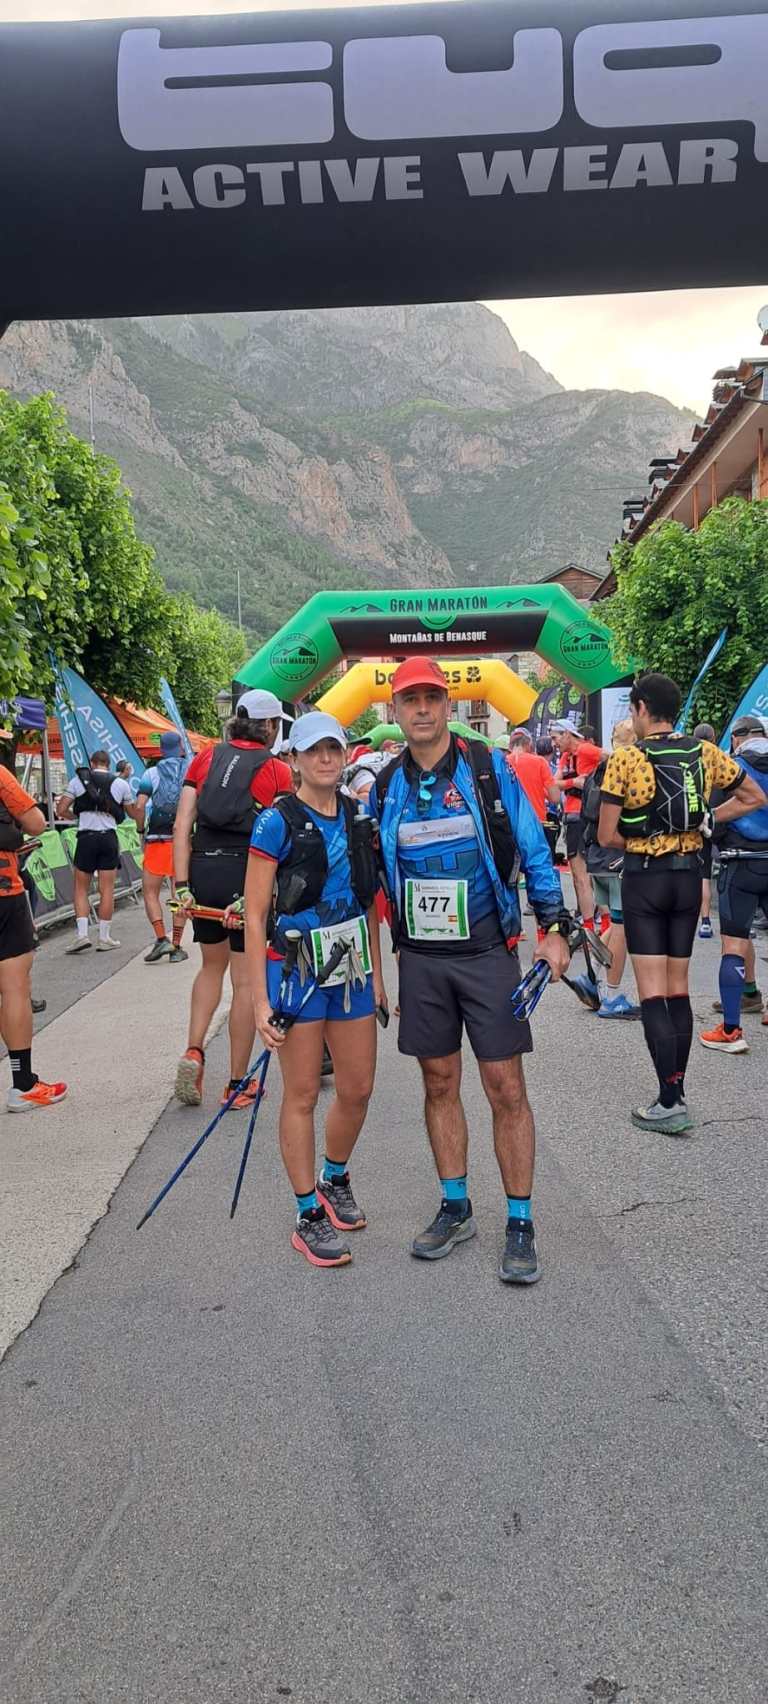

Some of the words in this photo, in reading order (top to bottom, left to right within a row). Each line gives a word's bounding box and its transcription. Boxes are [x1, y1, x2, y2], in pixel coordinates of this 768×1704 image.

[141, 156, 423, 211] ACTIVE
[457, 139, 738, 197] WEAR
[390, 599, 422, 612] GRAN
[428, 596, 487, 611] MARATÓN
[434, 632, 445, 642] DE
[446, 631, 487, 642] BENASQUE
[418, 896, 450, 912] 477
